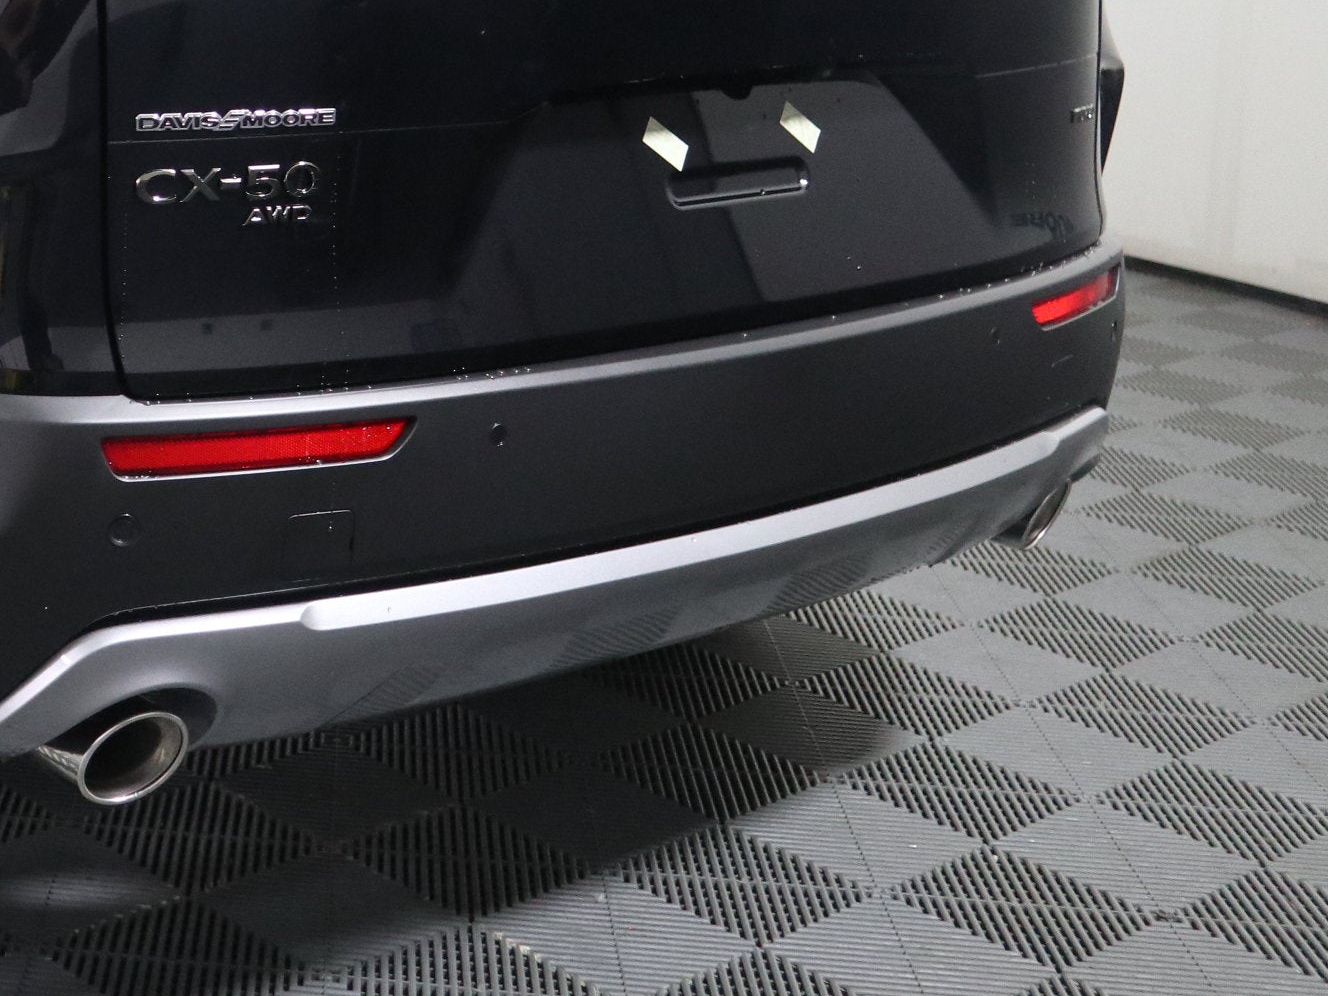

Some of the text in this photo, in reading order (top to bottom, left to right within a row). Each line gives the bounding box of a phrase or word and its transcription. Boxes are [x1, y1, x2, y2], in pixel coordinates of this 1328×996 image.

[135, 107, 337, 132] DAVIS MOORE
[135, 160, 321, 205] CX-50
[242, 204, 314, 227] AWD
